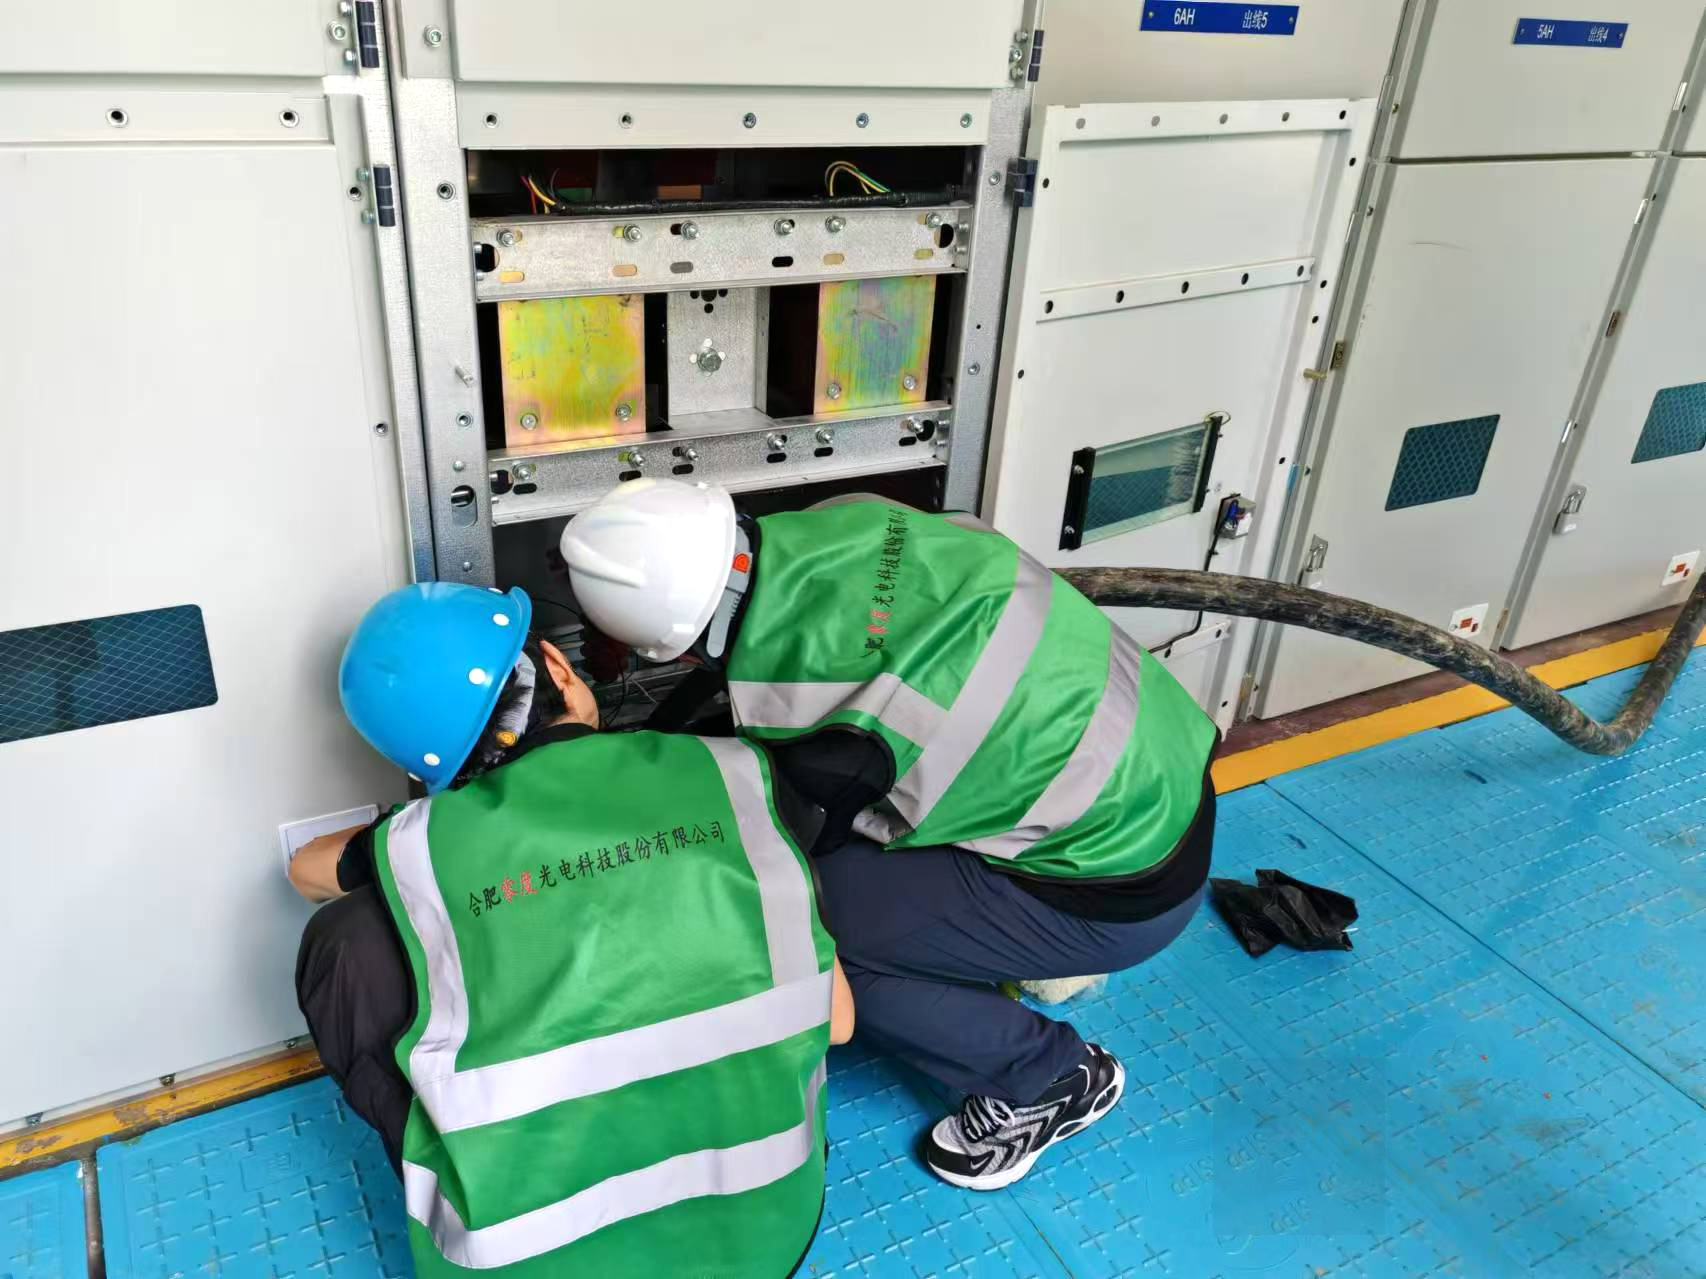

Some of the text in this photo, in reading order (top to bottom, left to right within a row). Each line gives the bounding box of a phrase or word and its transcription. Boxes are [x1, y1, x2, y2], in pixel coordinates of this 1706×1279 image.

[1174, 8, 1269, 30] 6AH 出线5
[1536, 24, 1556, 39] 5AH
